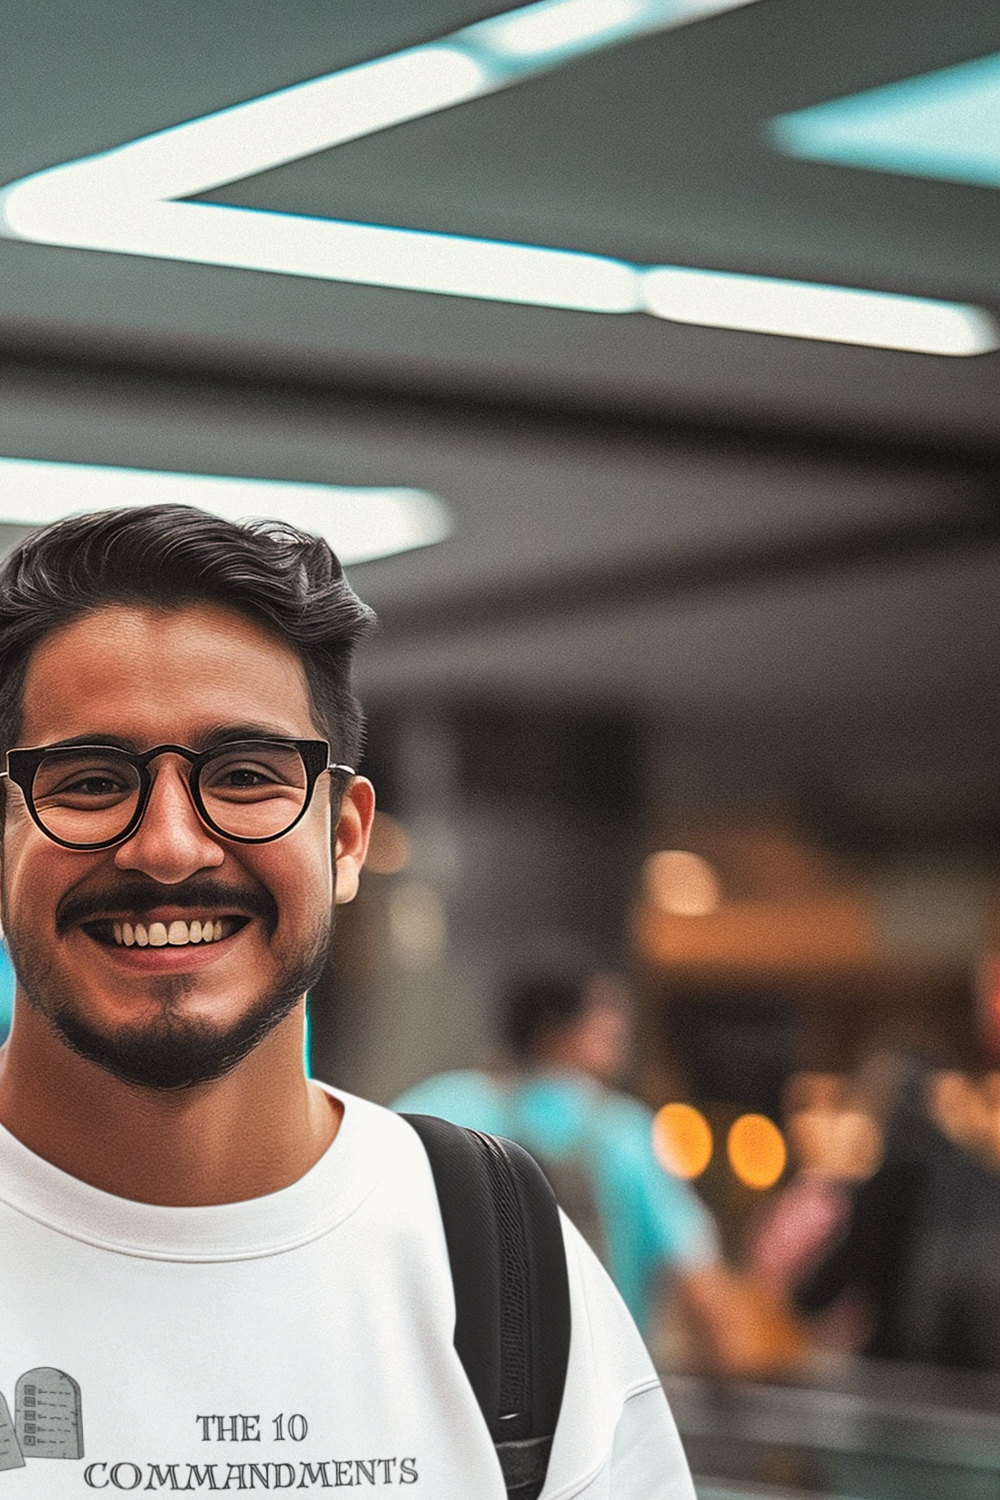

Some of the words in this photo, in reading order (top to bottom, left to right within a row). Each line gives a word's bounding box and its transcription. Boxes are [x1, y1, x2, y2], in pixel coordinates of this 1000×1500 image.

[195, 1413, 262, 1443] THE
[271, 1412, 309, 1443] 10
[83, 1456, 419, 1491] COMMANDMENTS
